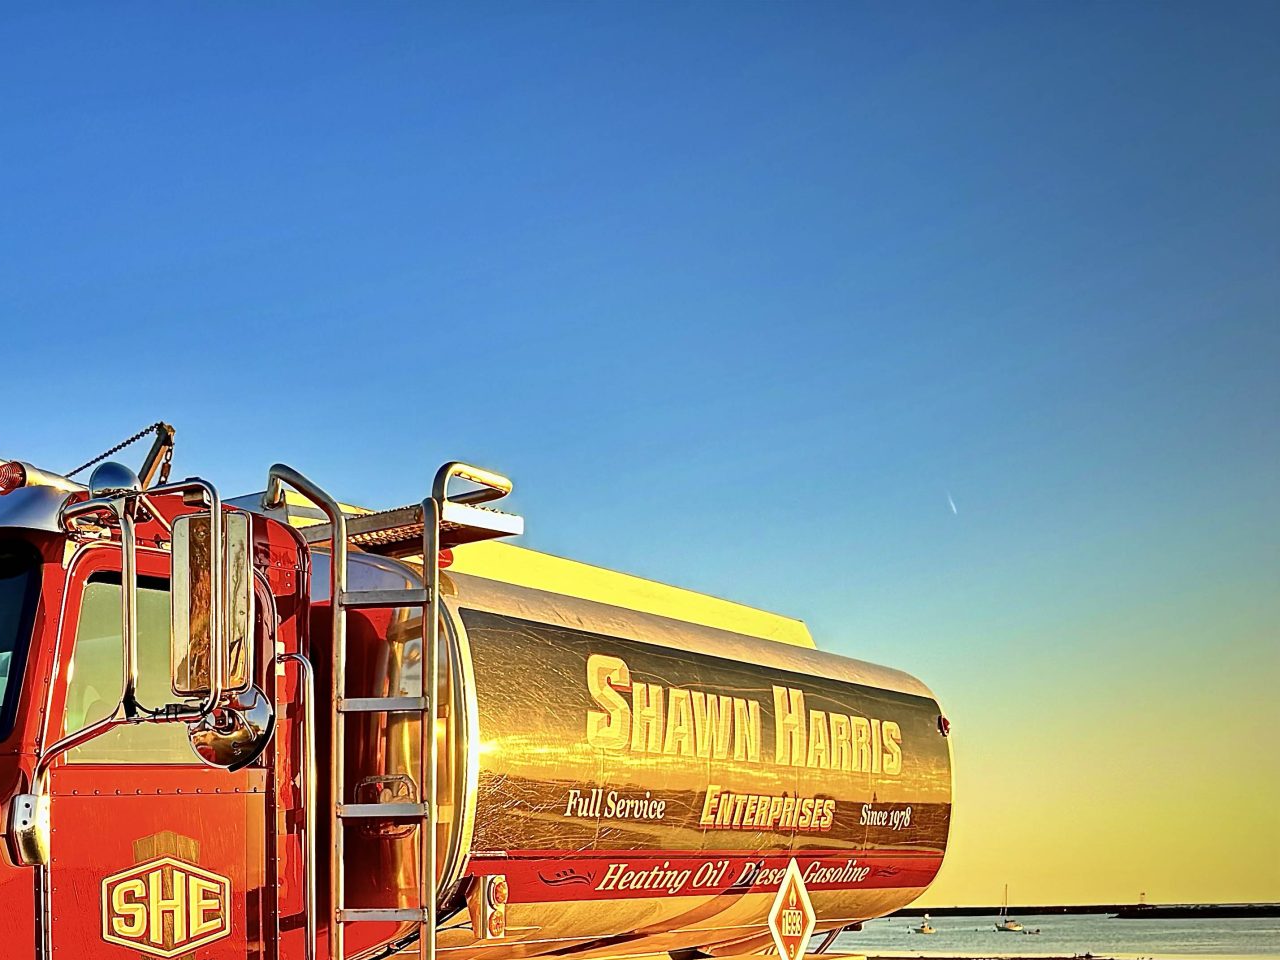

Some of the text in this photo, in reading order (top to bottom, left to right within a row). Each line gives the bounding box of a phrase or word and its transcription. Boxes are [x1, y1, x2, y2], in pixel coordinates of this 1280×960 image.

[586, 654, 903, 776] SHAWN HARRIS
[563, 789, 666, 820] Full Service
[699, 784, 836, 832] ENTERPRISES
[859, 803, 912, 831] Since 1978
[595, 860, 871, 894] Heating Oil Diese Gasoline
[111, 868, 223, 946] SHE
[782, 910, 803, 936] 1993
[789, 944, 795, 959] 3
